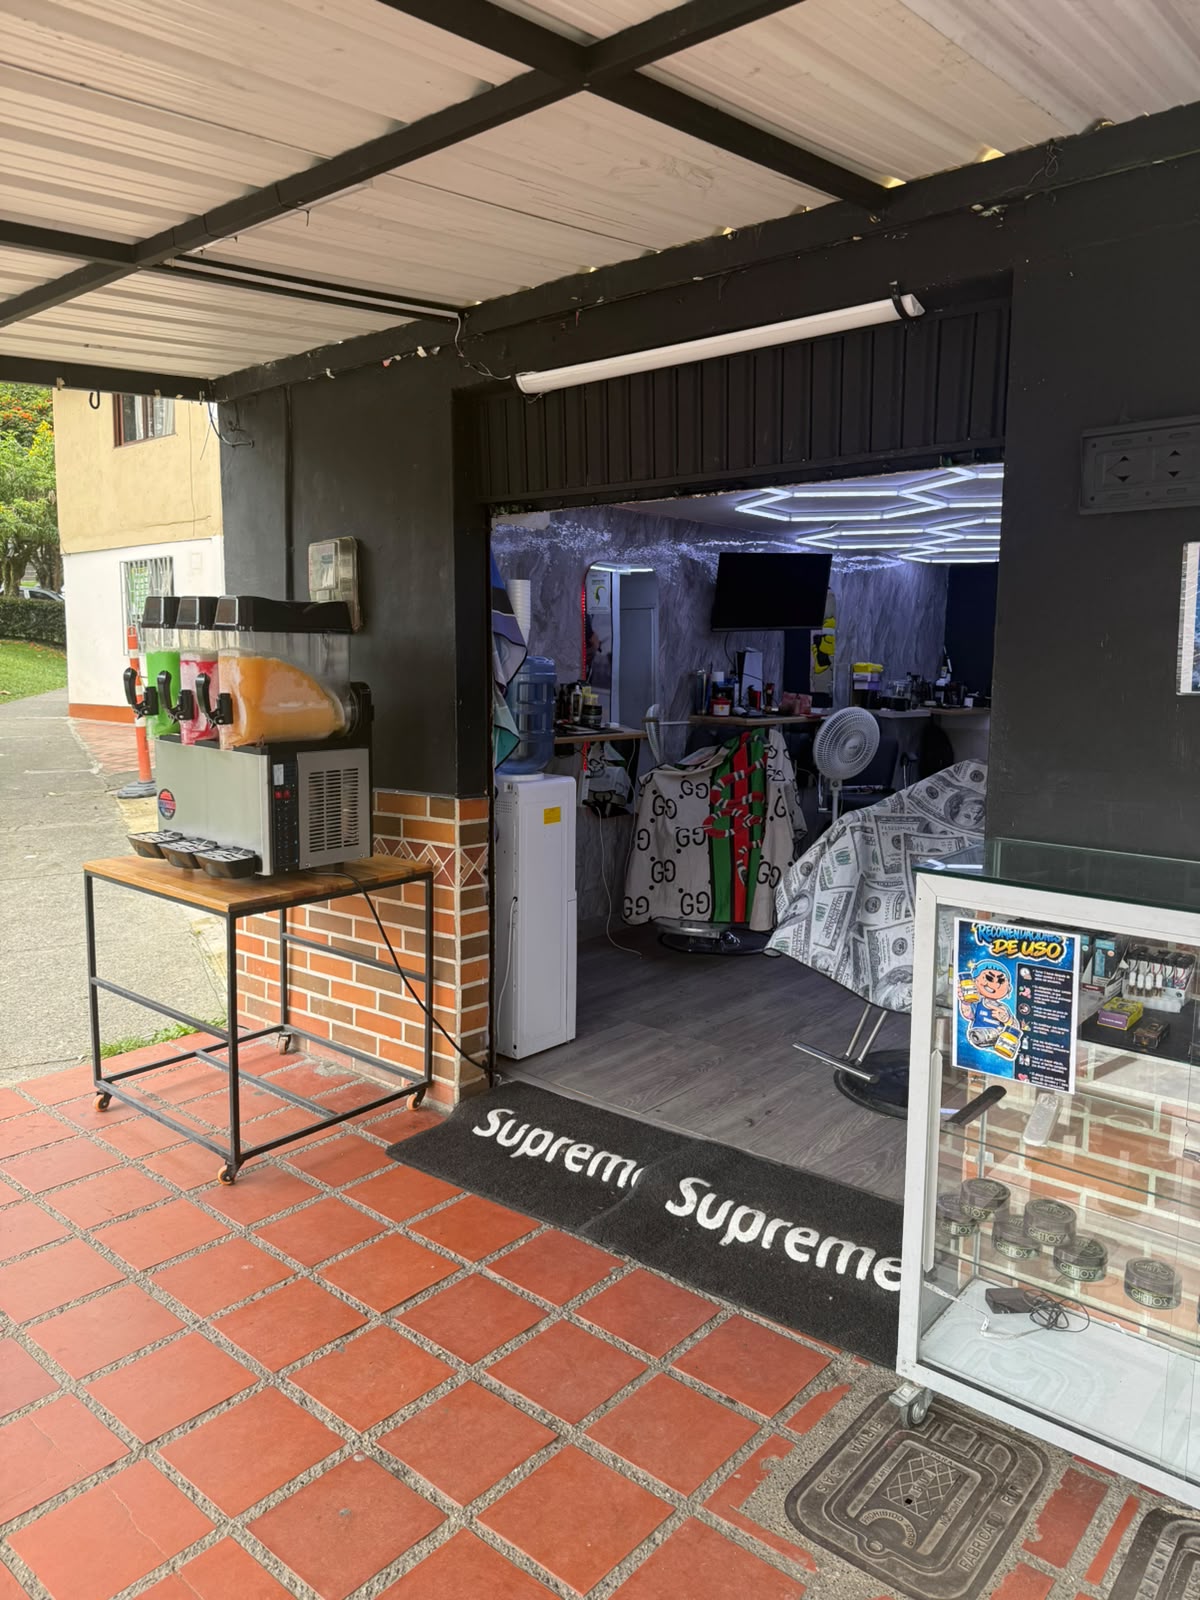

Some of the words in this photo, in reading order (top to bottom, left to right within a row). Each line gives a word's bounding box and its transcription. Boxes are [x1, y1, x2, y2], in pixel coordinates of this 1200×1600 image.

[992, 939, 1018, 956] DE
[1021, 942, 1061, 959] USO
[665, 1177, 902, 1292] Supreme
[849, 1418, 885, 1453] FURIMA
[957, 1511, 1005, 1573] FABRICADO
